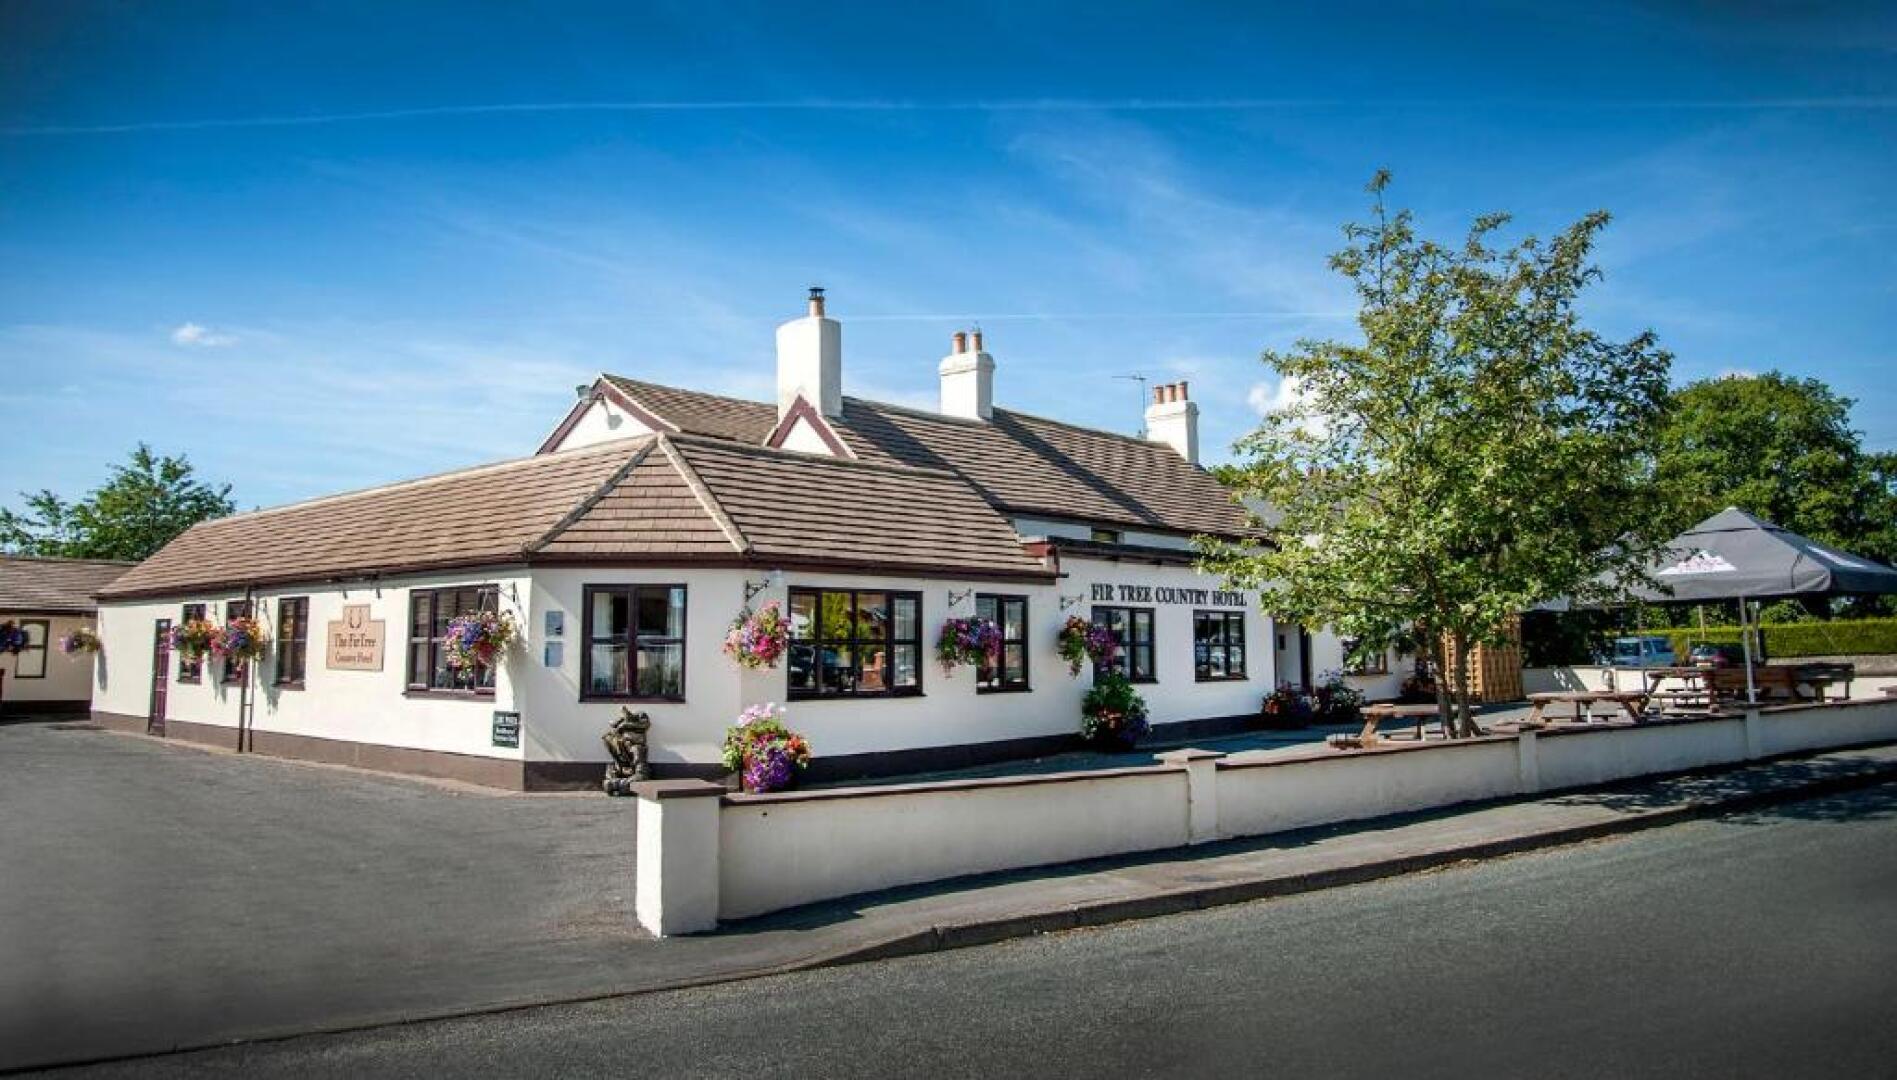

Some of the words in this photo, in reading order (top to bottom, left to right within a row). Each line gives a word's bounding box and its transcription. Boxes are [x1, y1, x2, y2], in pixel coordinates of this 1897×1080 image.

[1091, 583, 1114, 601] FIR
[1118, 584, 1152, 602] TREE
[1155, 586, 1208, 605] COUNTRY
[1213, 590, 1247, 606] HOTEL
[335, 633, 347, 647] The
